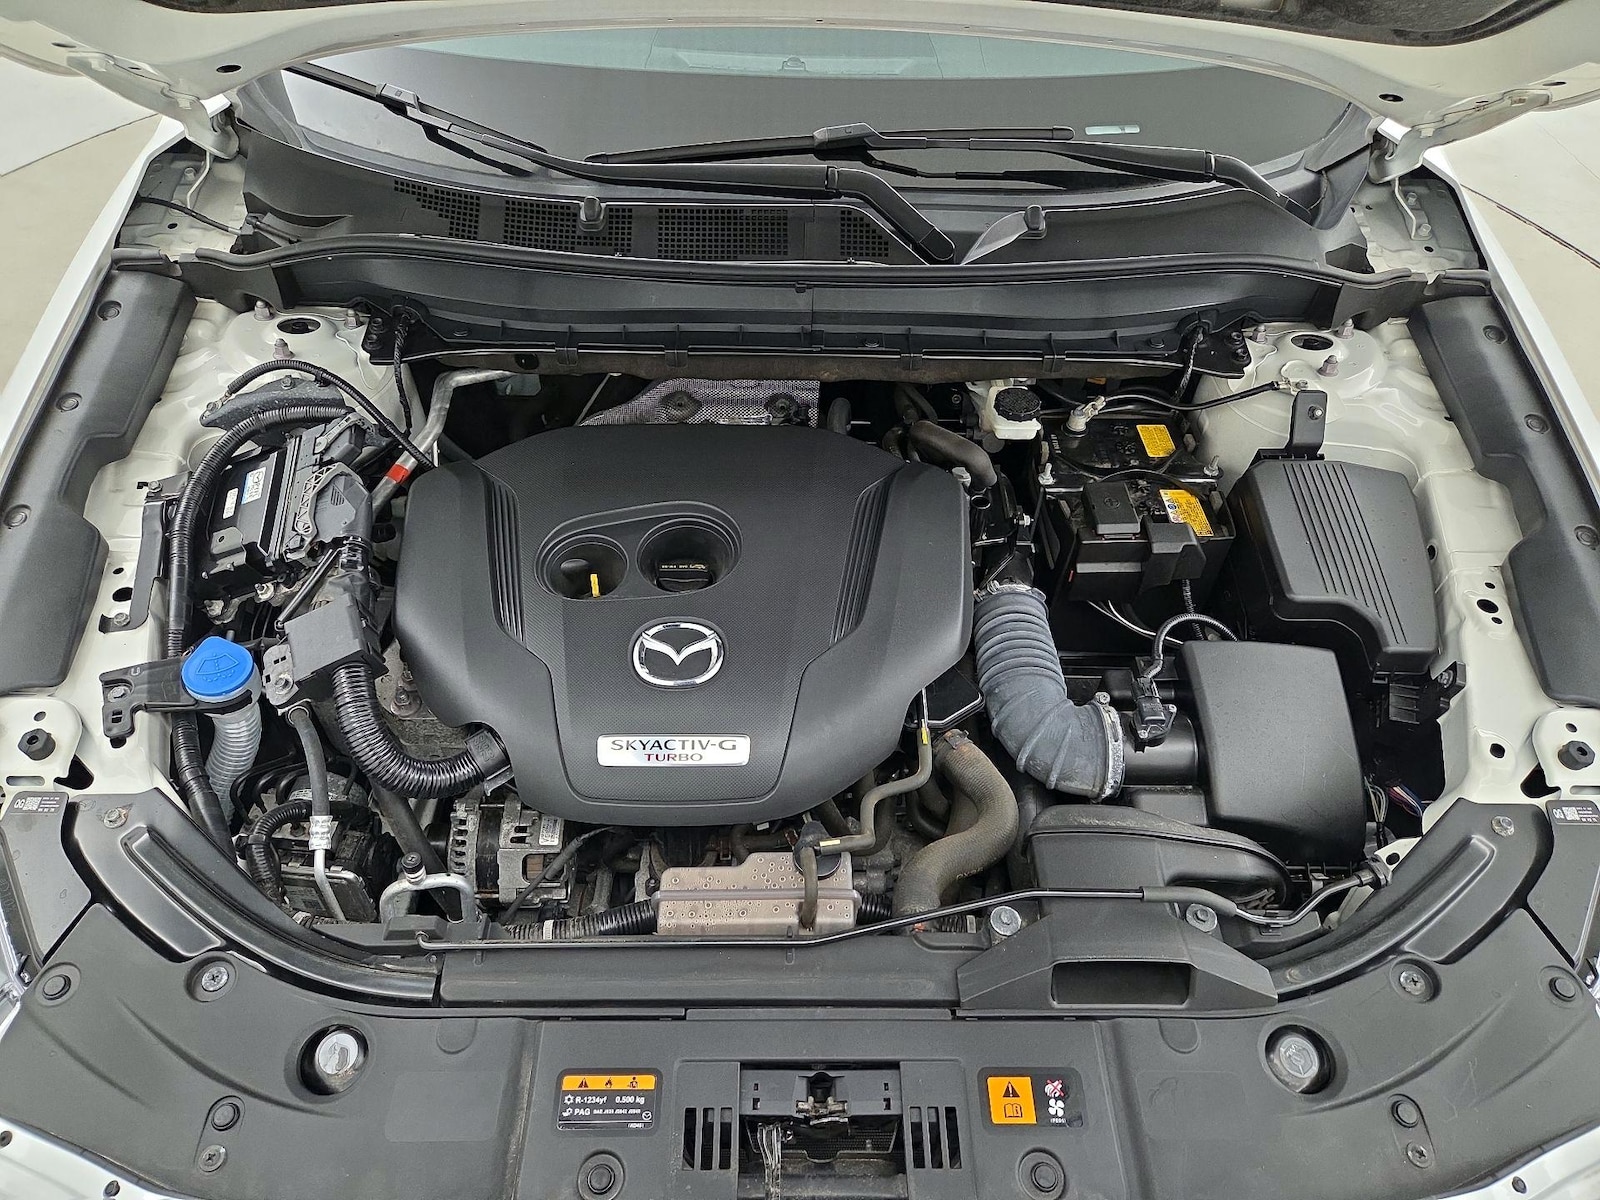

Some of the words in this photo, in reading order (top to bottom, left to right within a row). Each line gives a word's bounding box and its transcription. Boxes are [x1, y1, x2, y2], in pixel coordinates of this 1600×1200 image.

[610, 739, 737, 751] SKYACTIV-G
[644, 753, 704, 762] TURBO
[575, 1095, 607, 1105] R-1234yf
[615, 1095, 635, 1104] 0.500
[635, 1095, 645, 1105] kg
[574, 1107, 591, 1116] PAG
